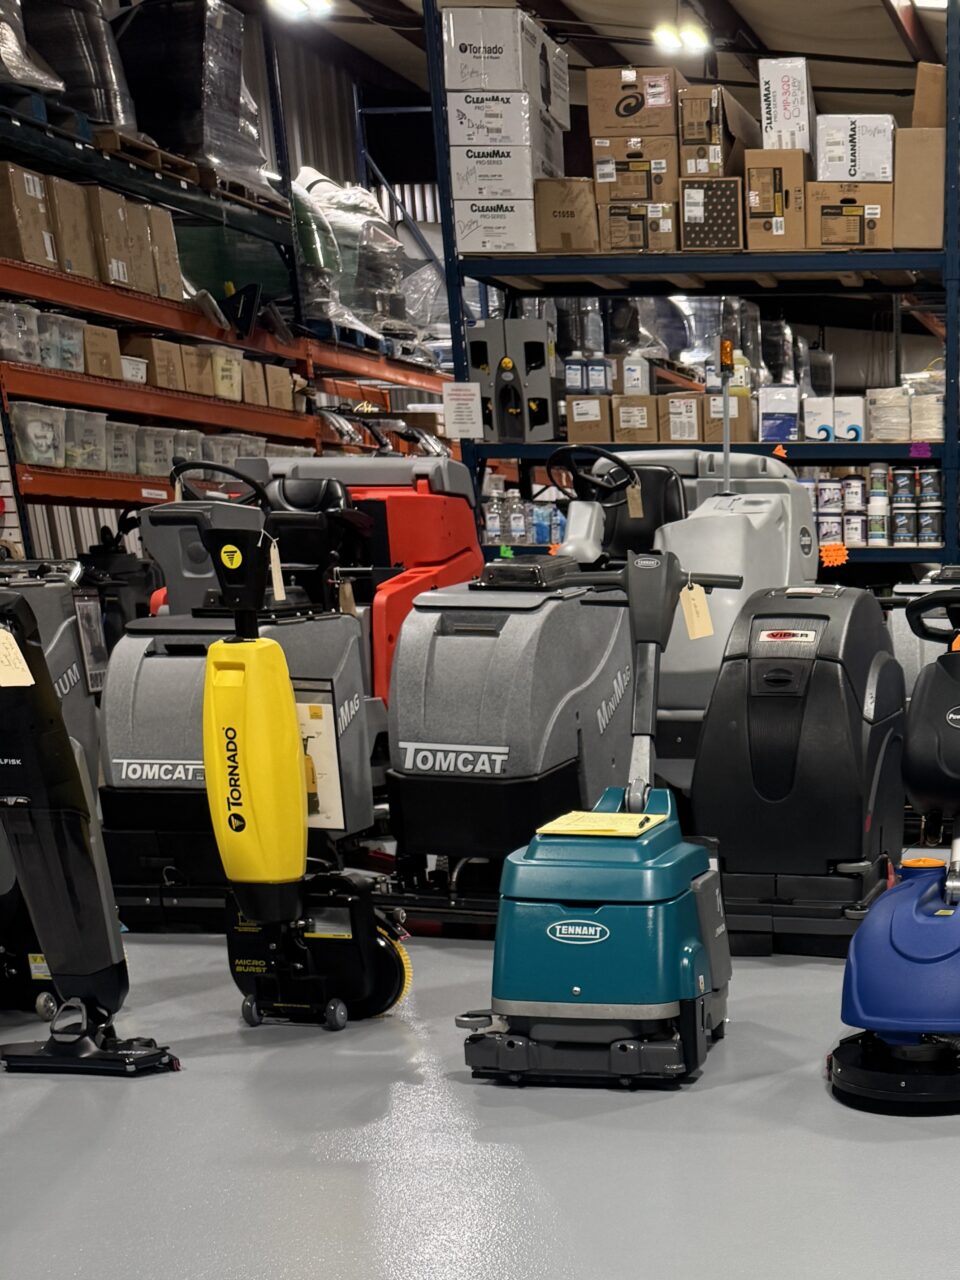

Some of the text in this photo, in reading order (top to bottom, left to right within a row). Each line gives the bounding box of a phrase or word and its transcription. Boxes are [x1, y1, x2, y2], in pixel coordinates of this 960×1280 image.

[0, 758, 22, 766] LFISK
[555, 925, 602, 939] TENNANT
[234, 959, 266, 967] MICRO
[235, 966, 268, 974] BURST
